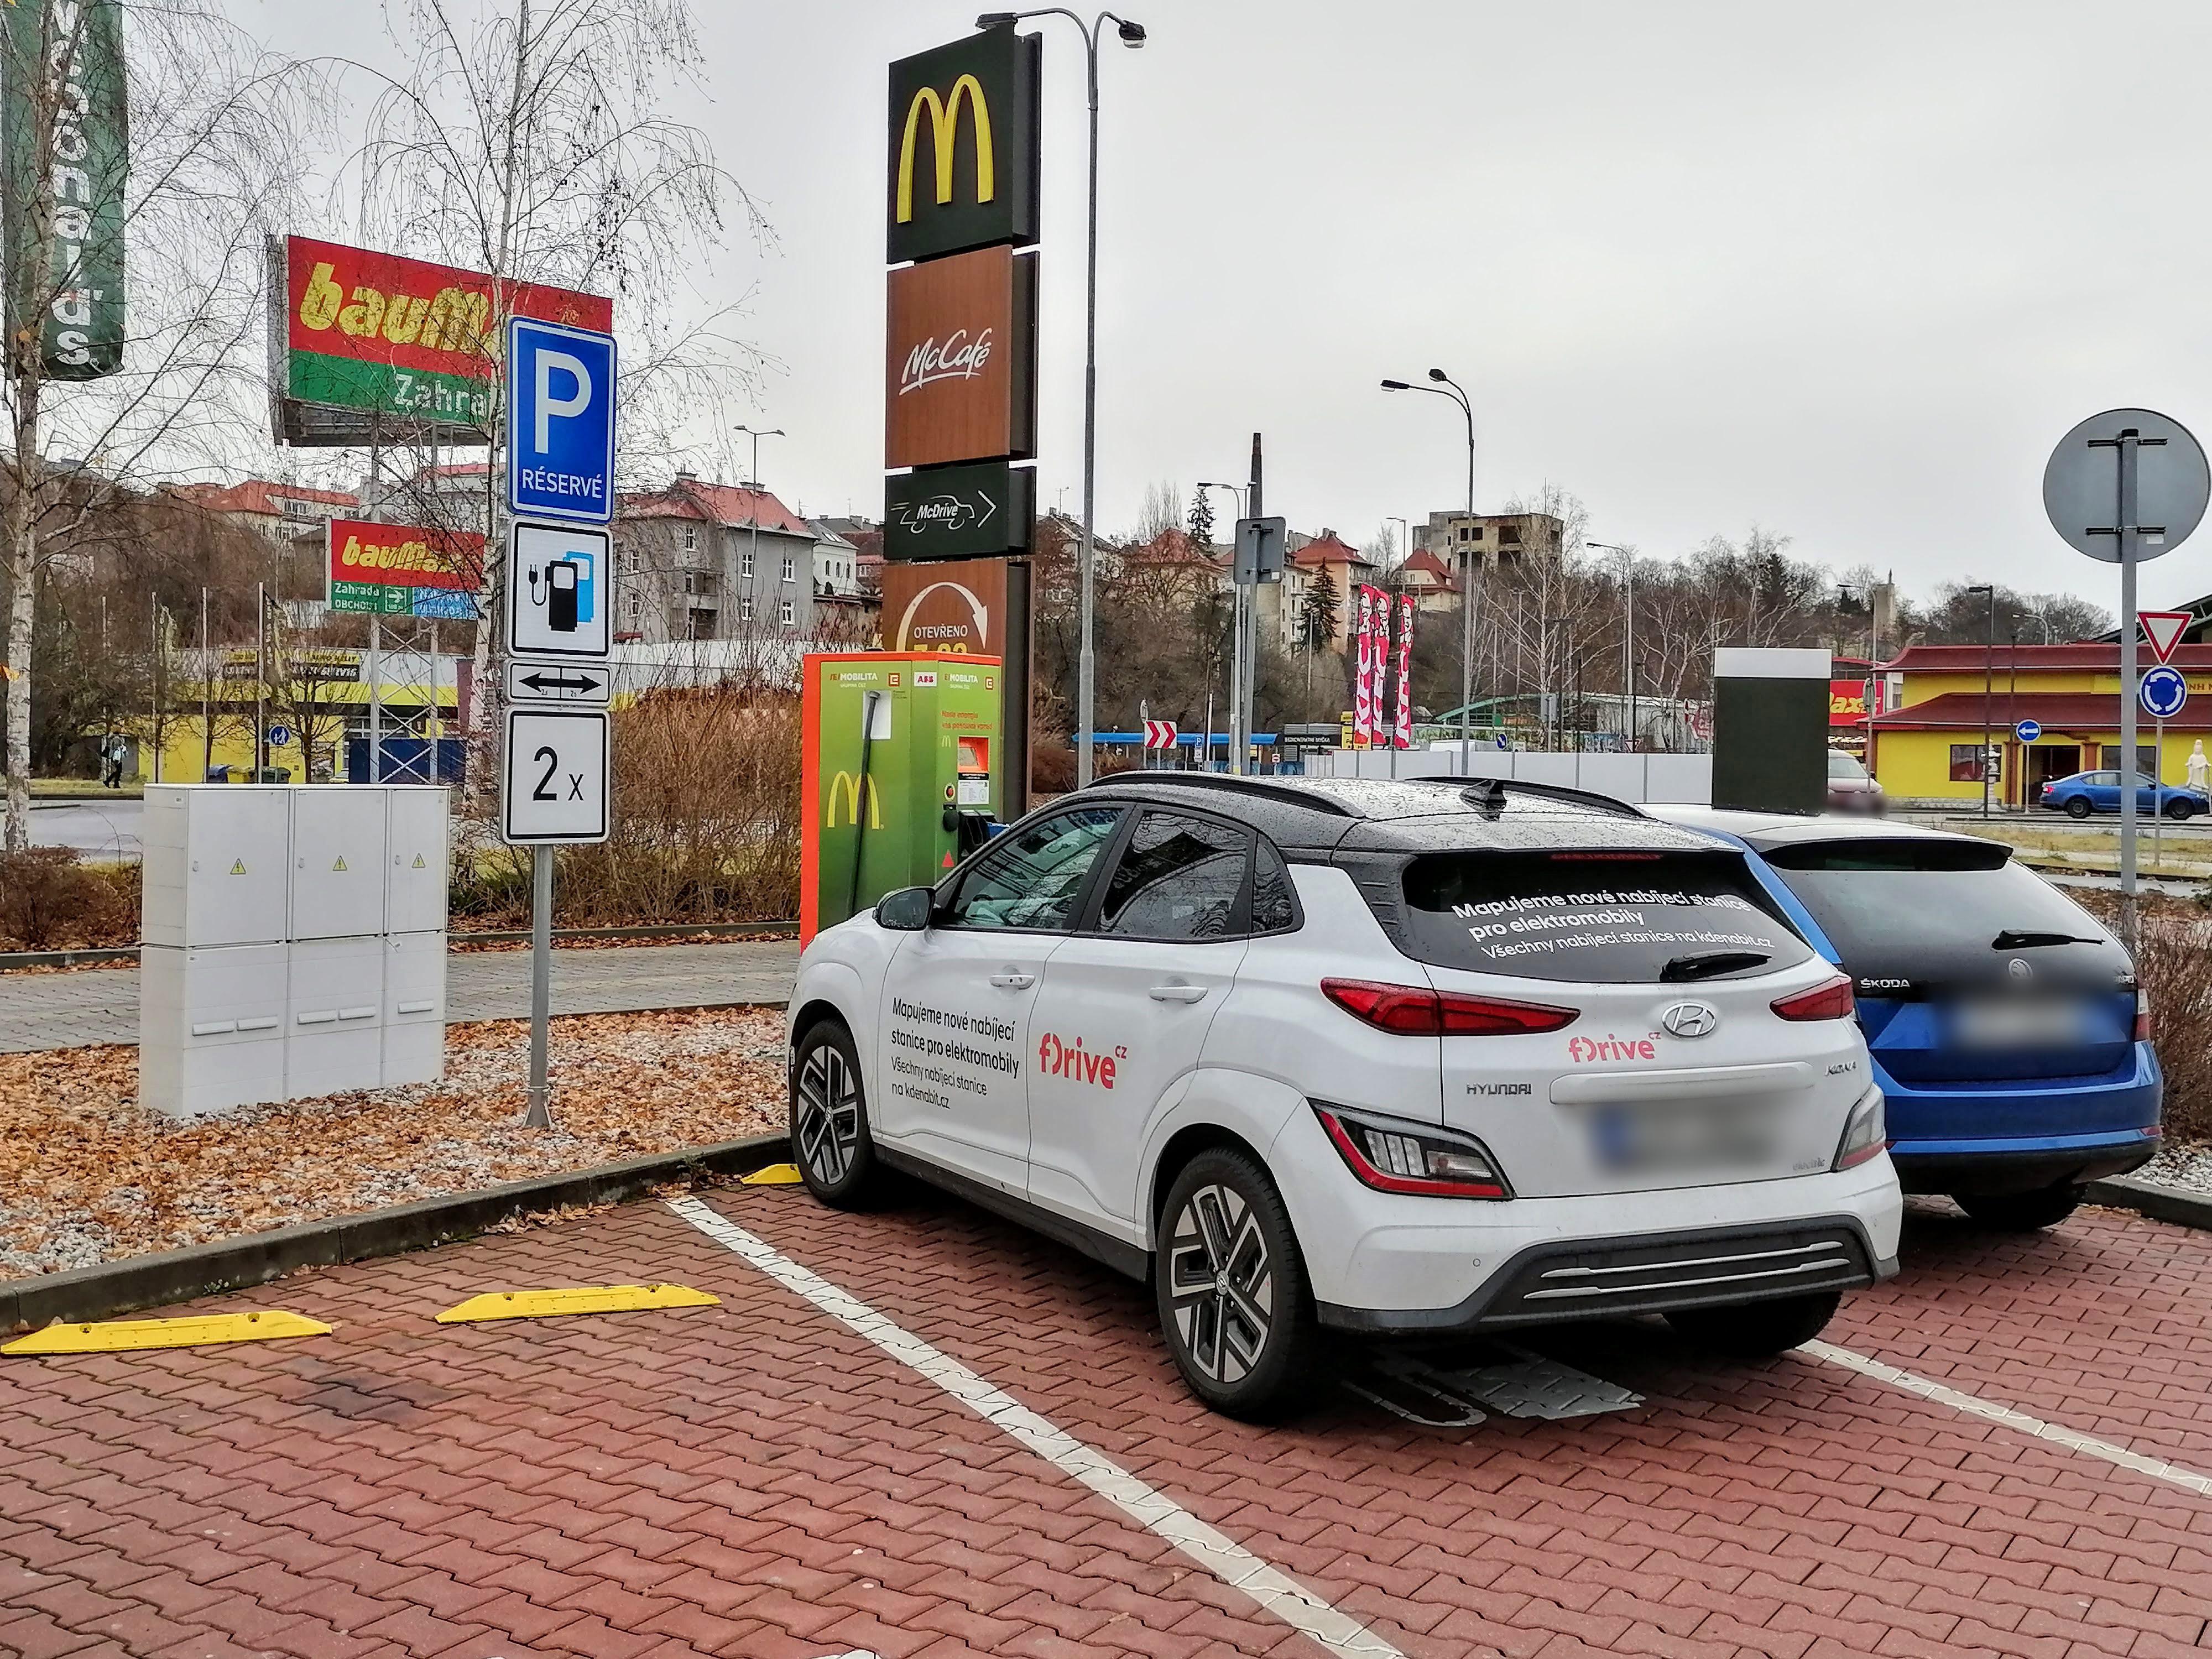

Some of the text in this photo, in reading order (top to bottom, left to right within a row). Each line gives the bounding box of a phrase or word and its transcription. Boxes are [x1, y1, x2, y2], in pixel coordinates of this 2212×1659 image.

[899, 327, 993, 394] McCafé
[394, 373, 490, 416] Zahra
[535, 348, 592, 454] P
[523, 466, 602, 498] RÉSERVÉ
[916, 503, 958, 519] McDrive
[335, 582, 380, 596] Zahrada
[914, 623, 968, 639] OTEVŘENO
[1452, 896, 1566, 919] Mapujeme
[1566, 890, 1616, 905] nové
[1689, 894, 1751, 911] stanice
[1469, 908, 1645, 942] pro elektromobily
[1480, 940, 1555, 959] Všechny
[1620, 929, 1675, 943] stanice
[1675, 931, 1695, 942] na
[1695, 930, 1775, 948] kdenabit.cz
[1860, 978, 1911, 989] ŠKODA
[893, 997, 1015, 1042] Mapujeme nové nabíjecí
[891, 1028, 1019, 1079] stanice pro elektromobily
[891, 1056, 924, 1081] Všechny
[957, 1075, 987, 1095] stanice
[1467, 1083, 1531, 1095] HYUNDAI
[891, 1082, 950, 1109] na kdenabit.cz
